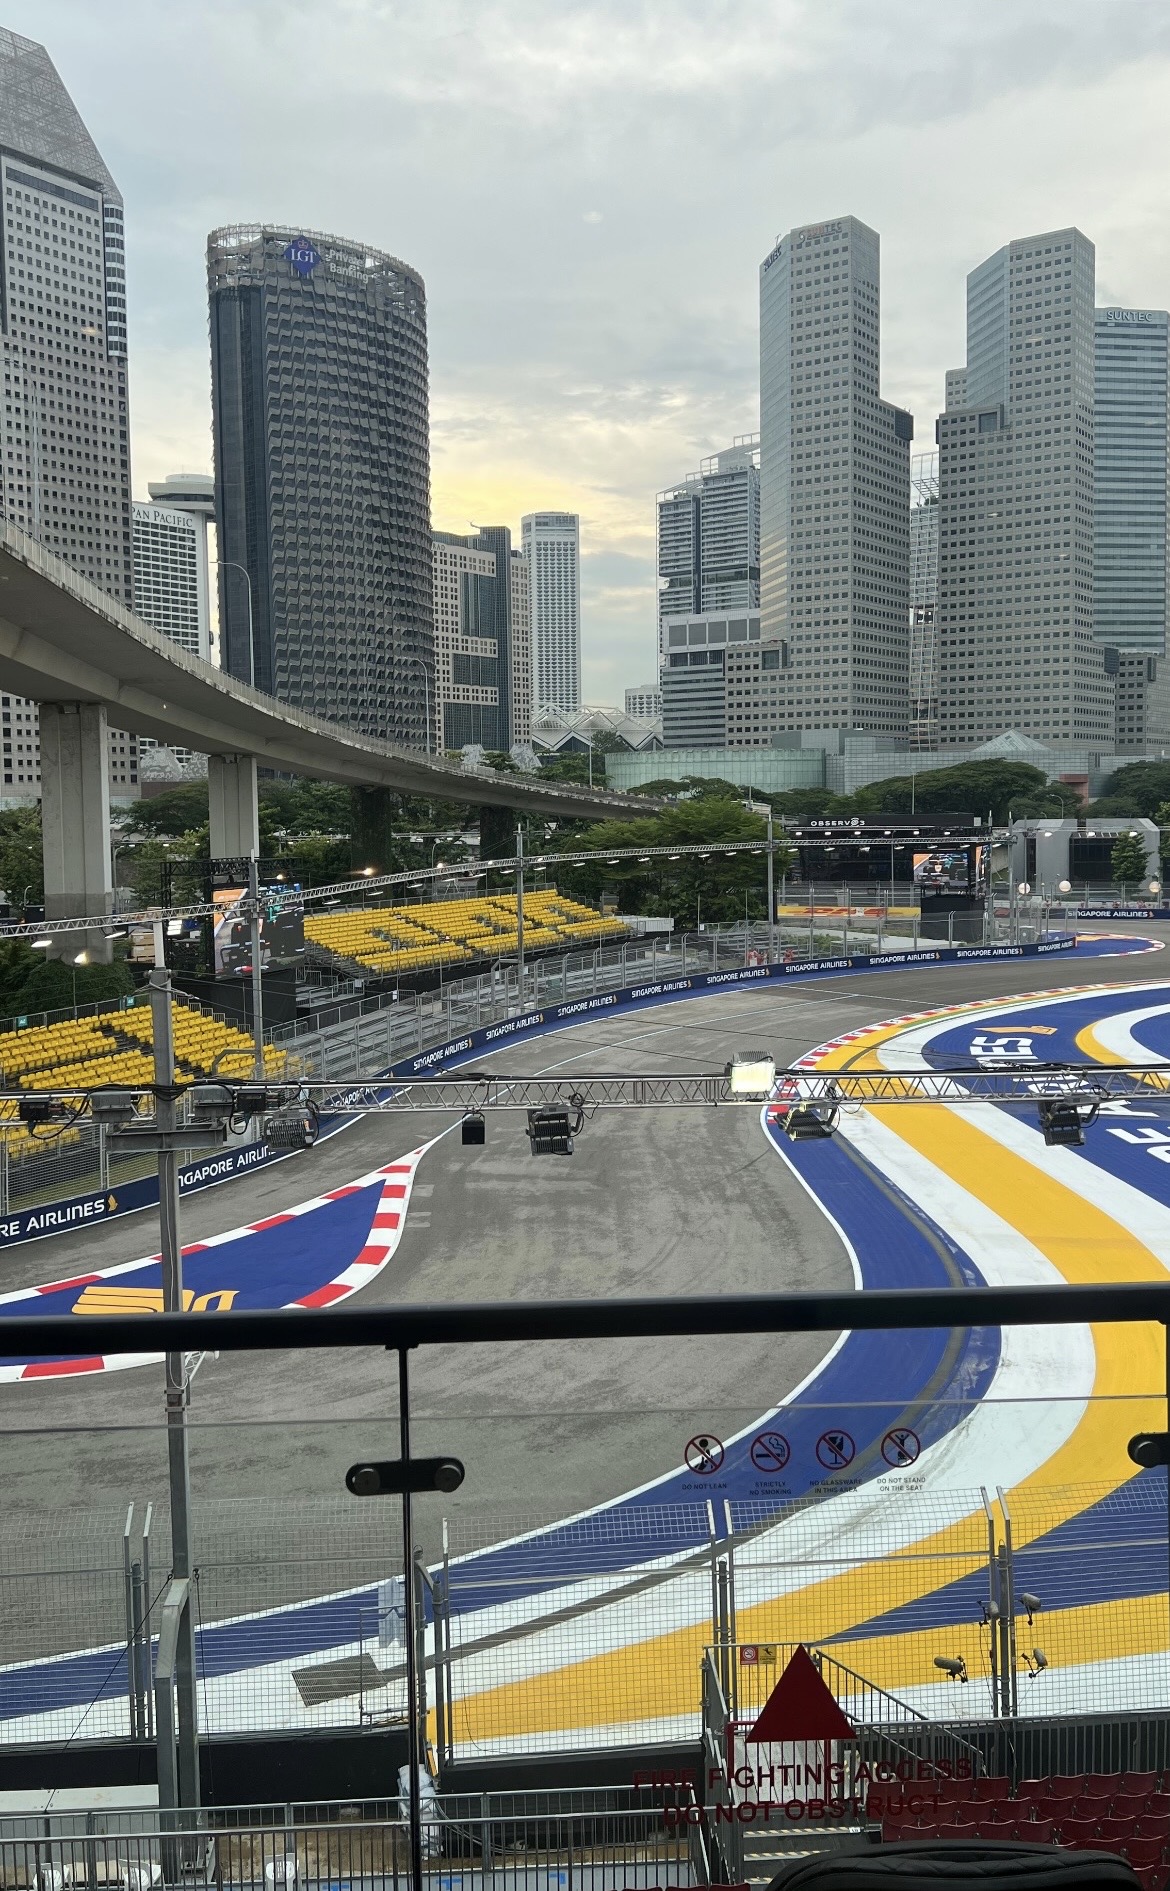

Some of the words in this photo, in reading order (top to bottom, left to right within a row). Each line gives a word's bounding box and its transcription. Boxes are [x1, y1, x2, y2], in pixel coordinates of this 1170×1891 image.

[291, 248, 317, 263] LGT
[329, 249, 365, 267] Private
[329, 262, 369, 284] Banking
[1107, 310, 1153, 322] SUNTEC
[131, 506, 150, 520] PAN
[154, 510, 193, 528] PACIFIC
[956, 949, 991, 957] SINGAPORE
[992, 948, 1019, 956] AIRLINES
[1037, 943, 1061, 952] SINGAPORE
[785, 963, 818, 973] SINGAPORE
[820, 960, 847, 969] AIRLINES
[869, 955, 905, 965] SINGAPORE
[906, 953, 935, 961] AIRLINES
[706, 972, 739, 984] SINGAPORE
[739, 968, 765, 979] AIRLINES
[631, 986, 662, 998] SINGAPORE
[662, 980, 687, 992] AIRLINES
[557, 1004, 588, 1017] SINGAPORE
[588, 995, 613, 1009] AIRLINES
[485, 1024, 515, 1040] SINGAPORE
[515, 1014, 540, 1030] AIRLINES
[413, 1049, 443, 1071] SINGAPORE
[444, 1039, 468, 1057] AIRLINES
[26, 1198, 105, 1232] AIRLINES
[632, 1767, 697, 1792] FIRE
[709, 1763, 845, 1789] FIGHTING
[854, 1757, 972, 1783] ACCESS
[663, 1803, 706, 1827] DO
[715, 1800, 775, 1824] NOT
[785, 1793, 944, 1821] OBSTRUCT
